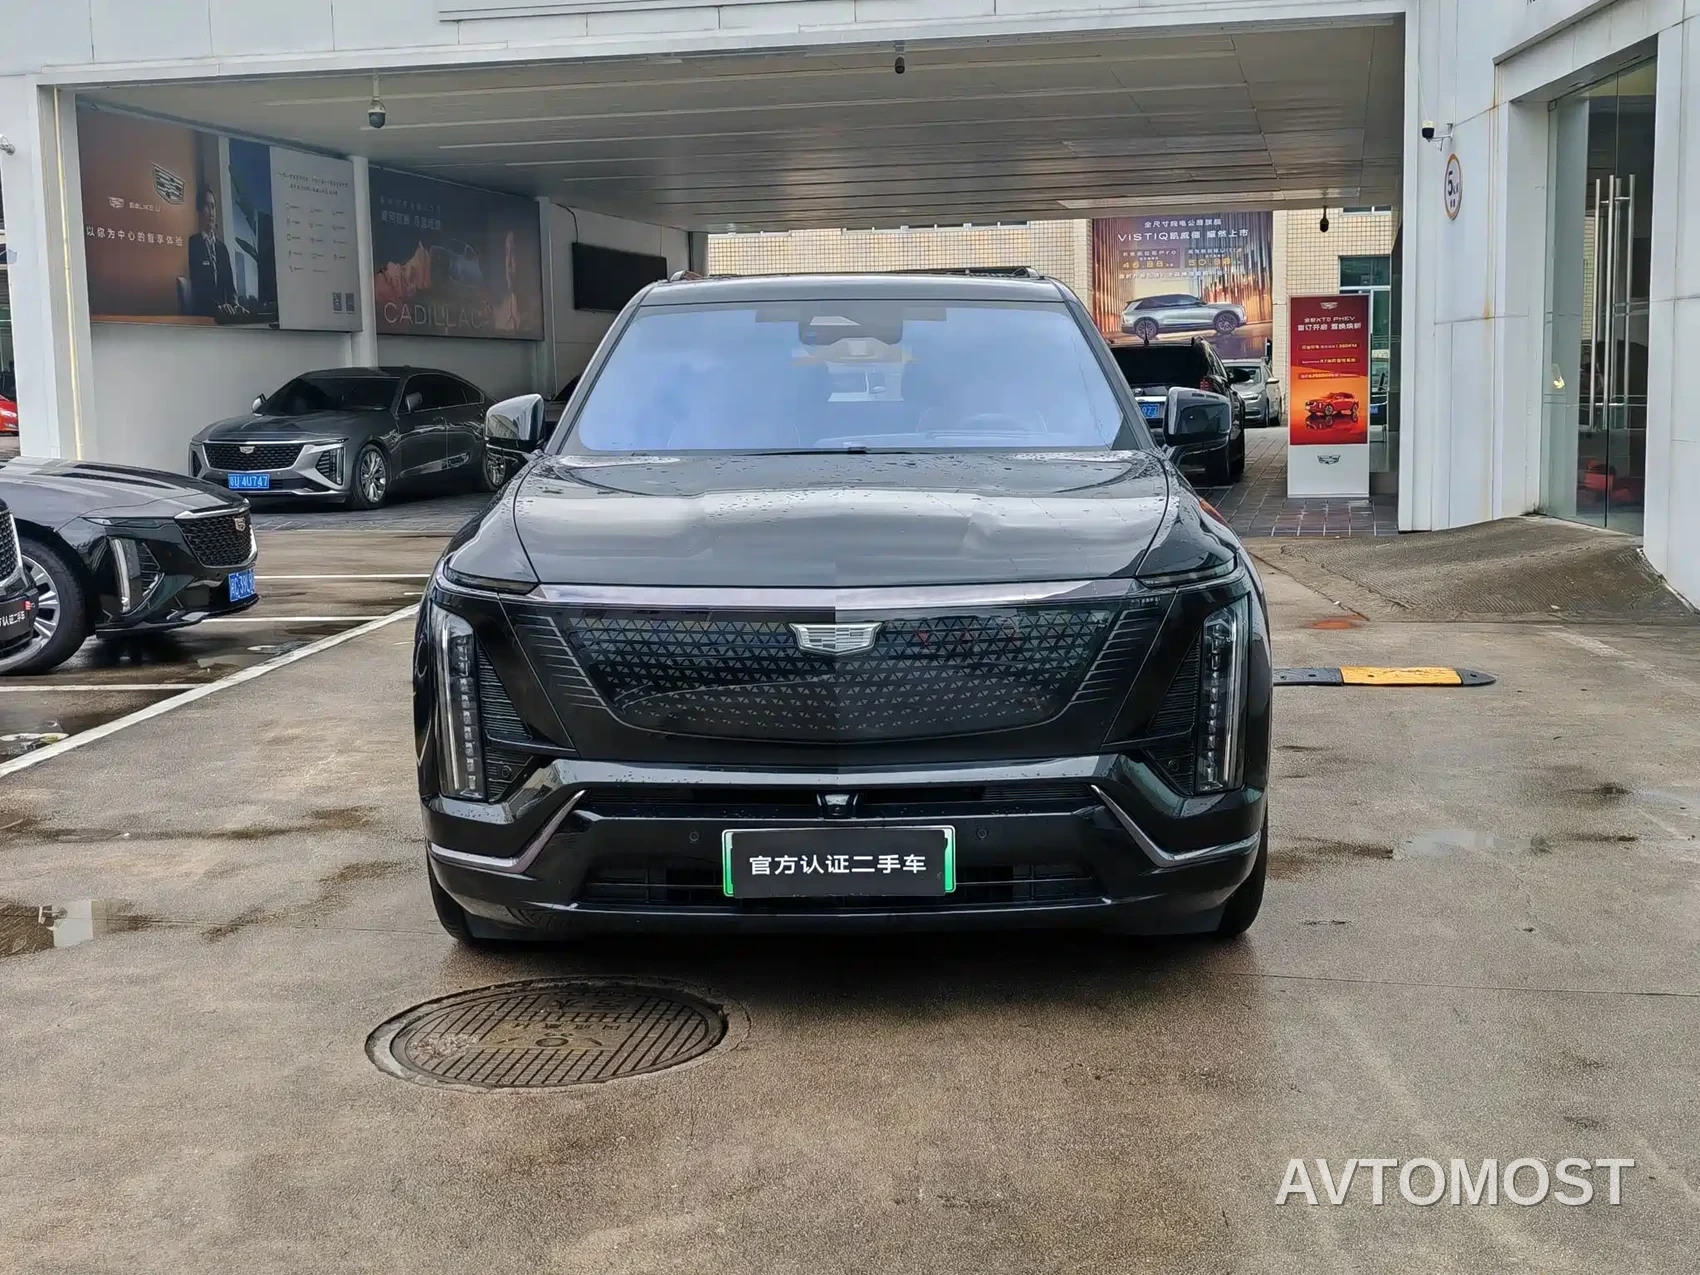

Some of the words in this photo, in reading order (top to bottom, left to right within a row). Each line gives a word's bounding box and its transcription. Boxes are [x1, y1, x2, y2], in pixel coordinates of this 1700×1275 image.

[749, 854, 927, 875] 官方认证二手车
